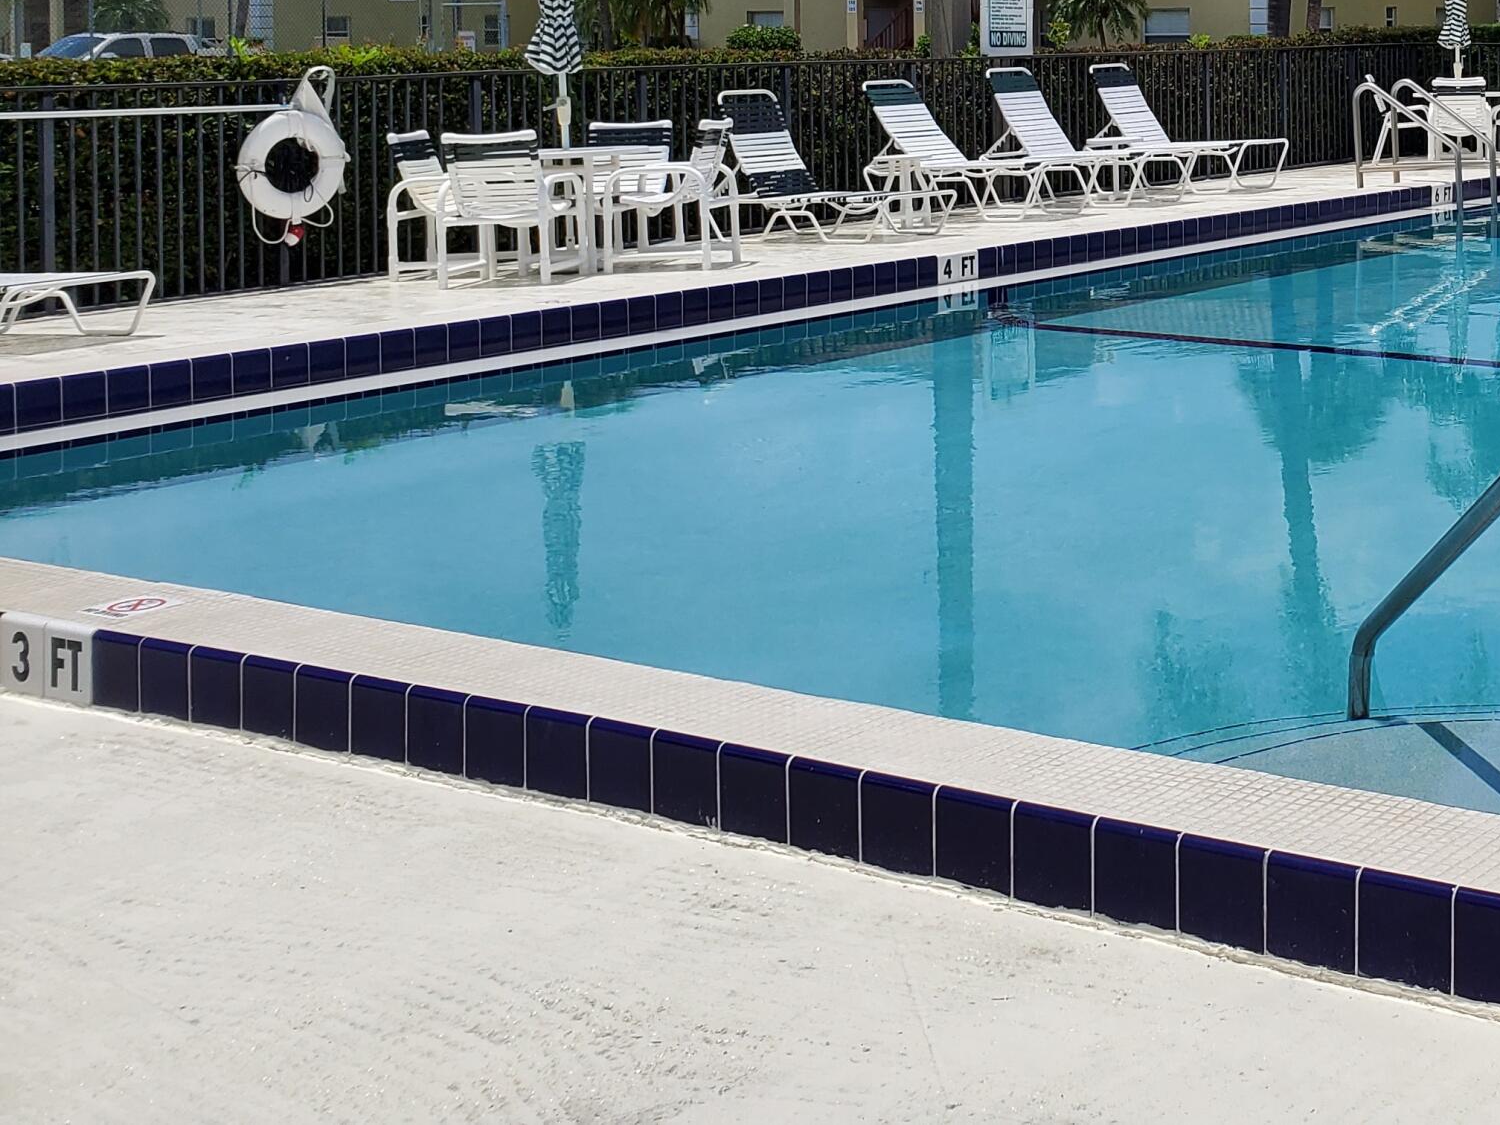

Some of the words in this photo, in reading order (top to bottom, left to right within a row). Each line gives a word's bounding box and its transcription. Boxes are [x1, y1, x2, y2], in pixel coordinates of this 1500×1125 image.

[991, 32, 1001, 46] NO
[1002, 32, 1026, 46] DIVING
[1434, 188, 1440, 203] 6
[1443, 187, 1451, 202] FT
[943, 258, 952, 279] 4
[961, 255, 976, 277] FT
[11, 631, 30, 683] 3
